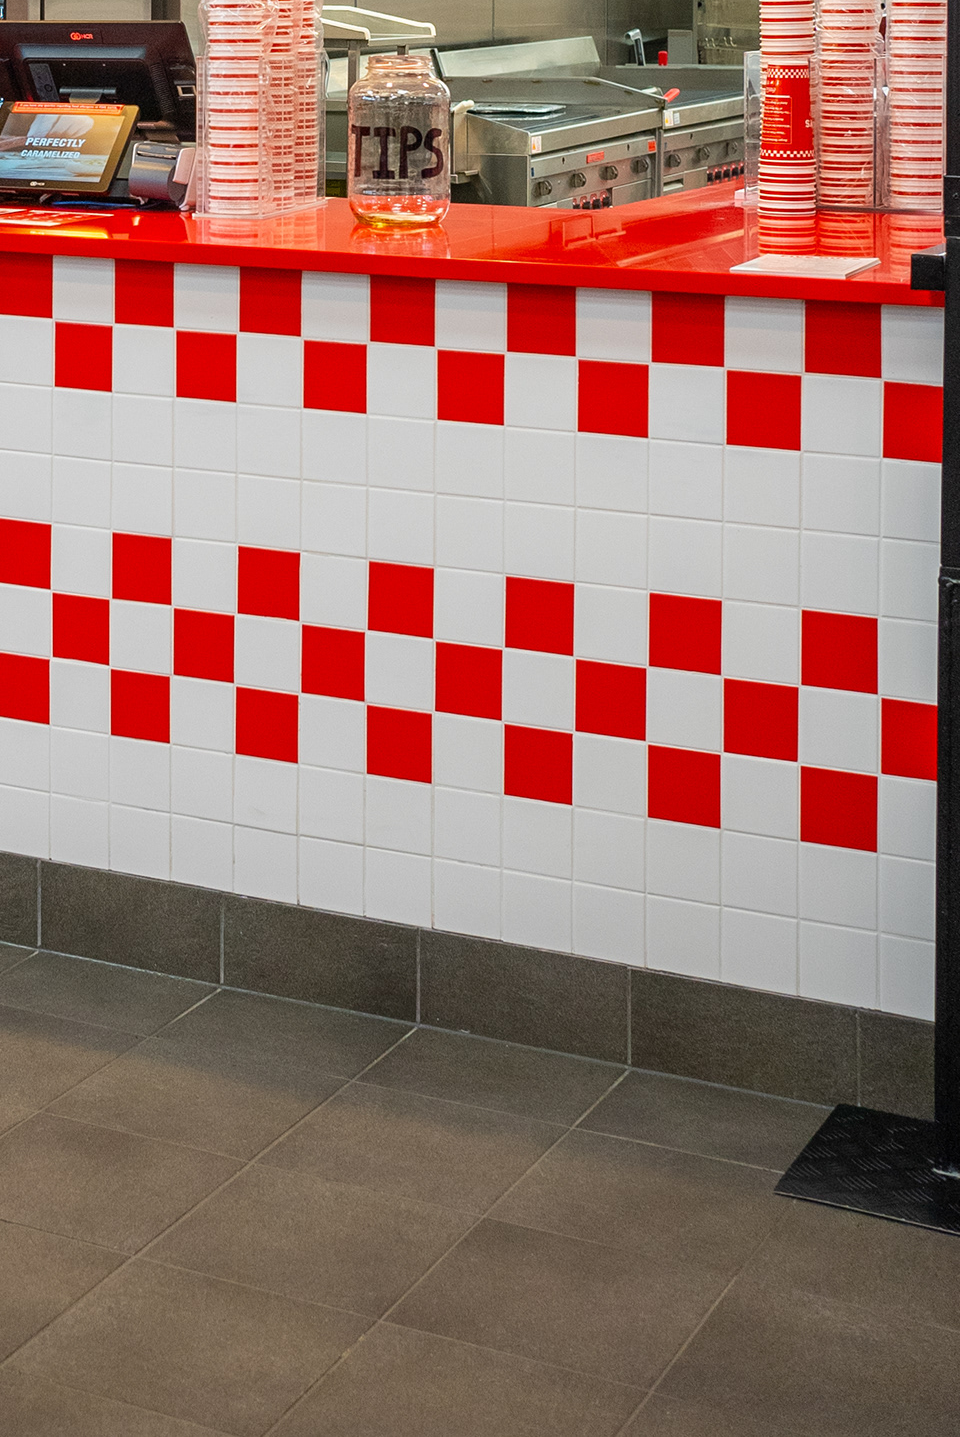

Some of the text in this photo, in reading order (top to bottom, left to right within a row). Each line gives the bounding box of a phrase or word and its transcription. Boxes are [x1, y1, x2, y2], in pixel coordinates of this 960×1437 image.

[25, 137, 86, 148] PERFECTLY
[20, 149, 81, 159] CARAMELIZED
[351, 123, 444, 179] TIPS
